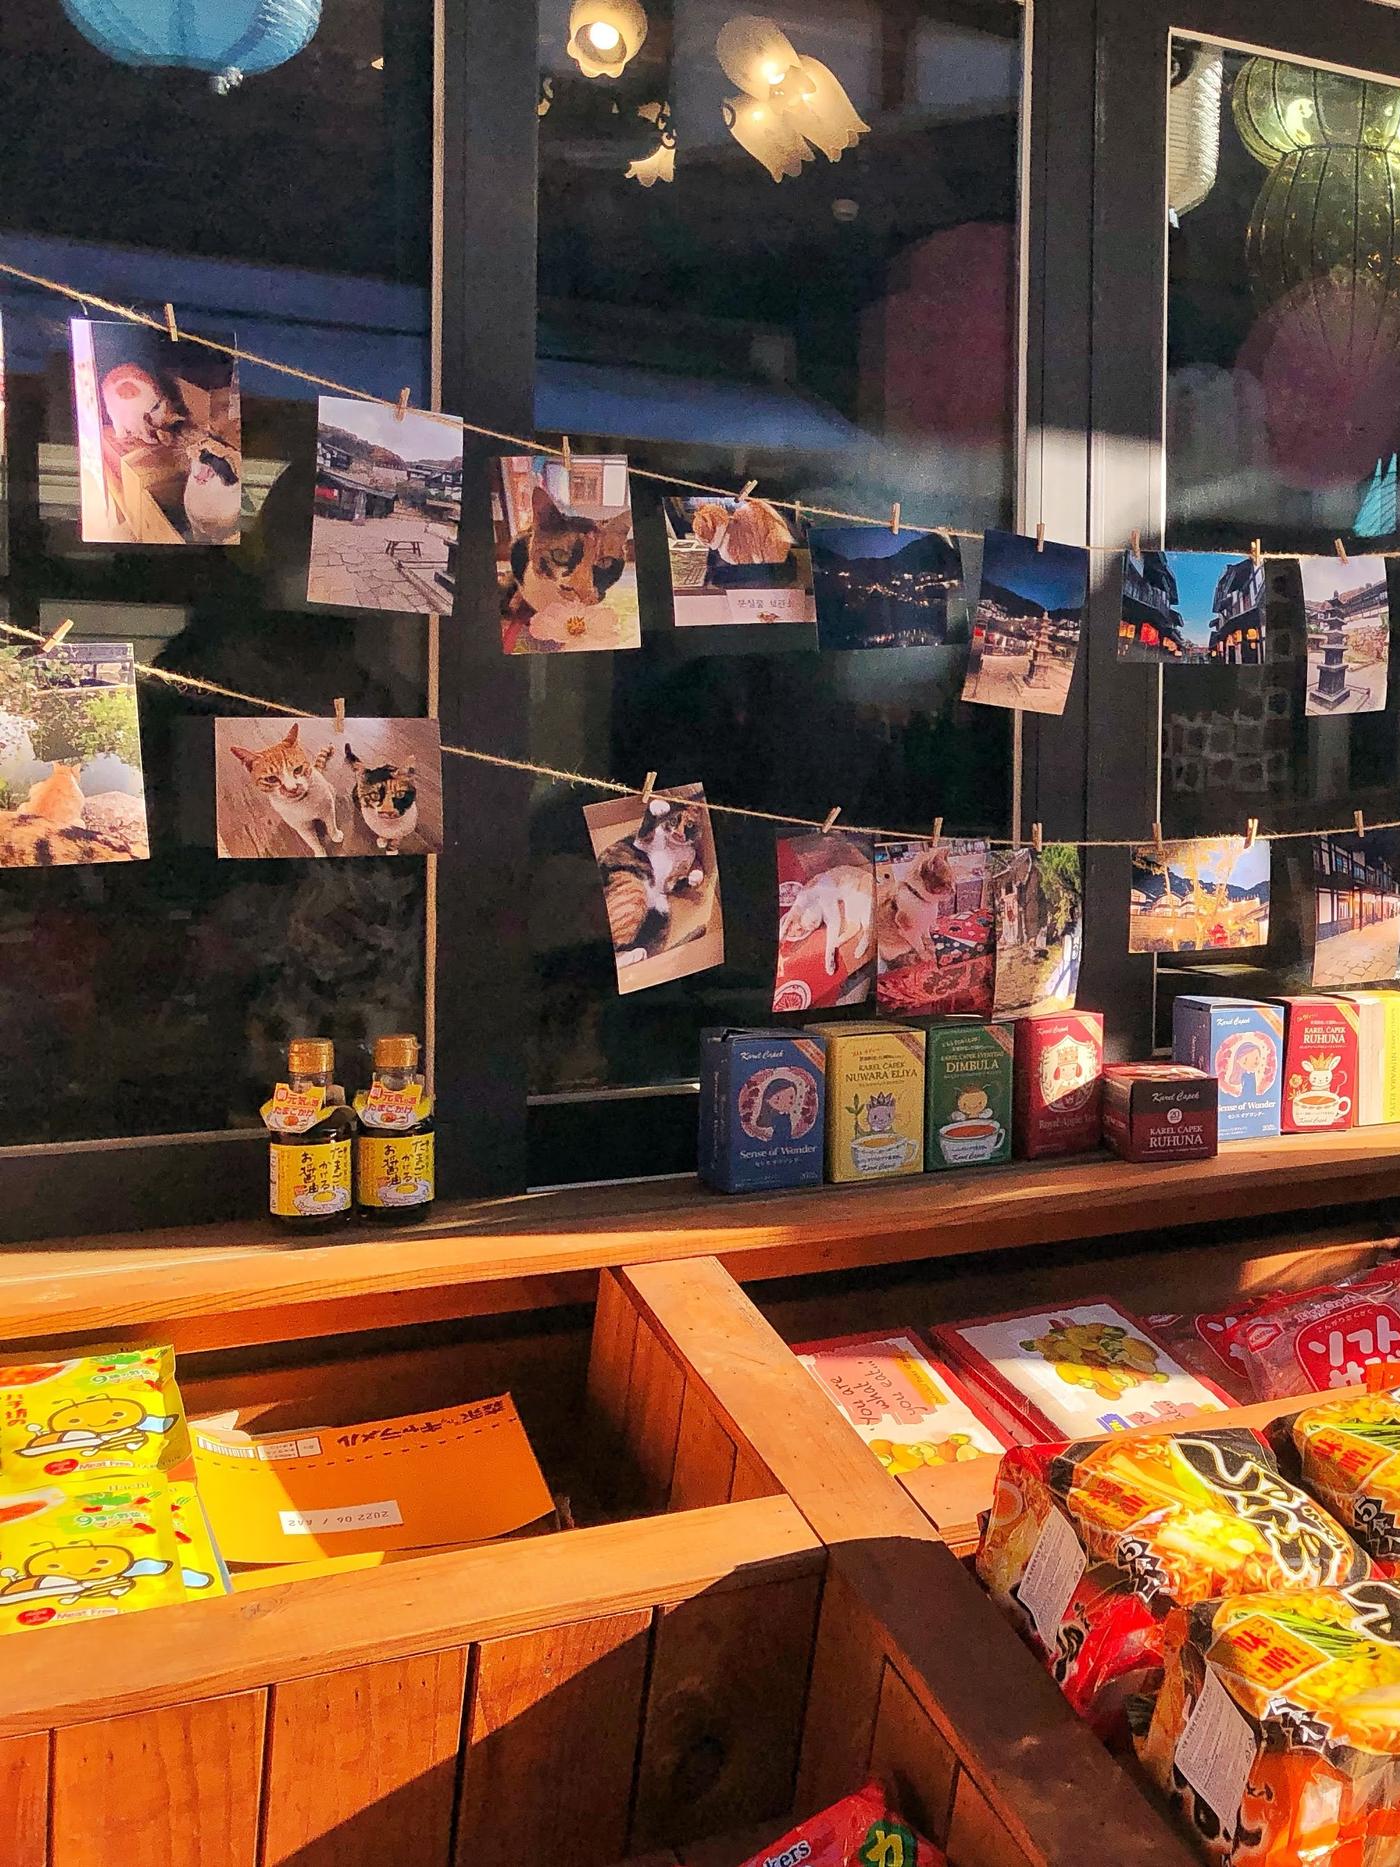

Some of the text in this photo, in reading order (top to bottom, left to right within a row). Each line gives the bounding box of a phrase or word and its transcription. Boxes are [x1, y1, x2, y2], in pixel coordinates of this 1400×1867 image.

[1304, 1034, 1345, 1044] RUHUNA
[945, 1059, 999, 1073] DIMBULA
[845, 1069, 918, 1082] NUWARA ELIYA
[1152, 1092, 1175, 1102] Karel
[1238, 1102, 1247, 1110] of
[1247, 1101, 1276, 1109] Wonder
[1150, 1127, 1176, 1136] KAREL
[1150, 1134, 1203, 1148] RUHUNA
[740, 1149, 766, 1159] Sense
[780, 1145, 817, 1155] Wonder
[1308, 1315, 1400, 1367] ソフト
[831, 1376, 854, 1395] are
[853, 1381, 889, 1410] what
[892, 1392, 928, 1415] you
[337, 1515, 352, 1523] 06
[357, 1510, 389, 1521] 2022
